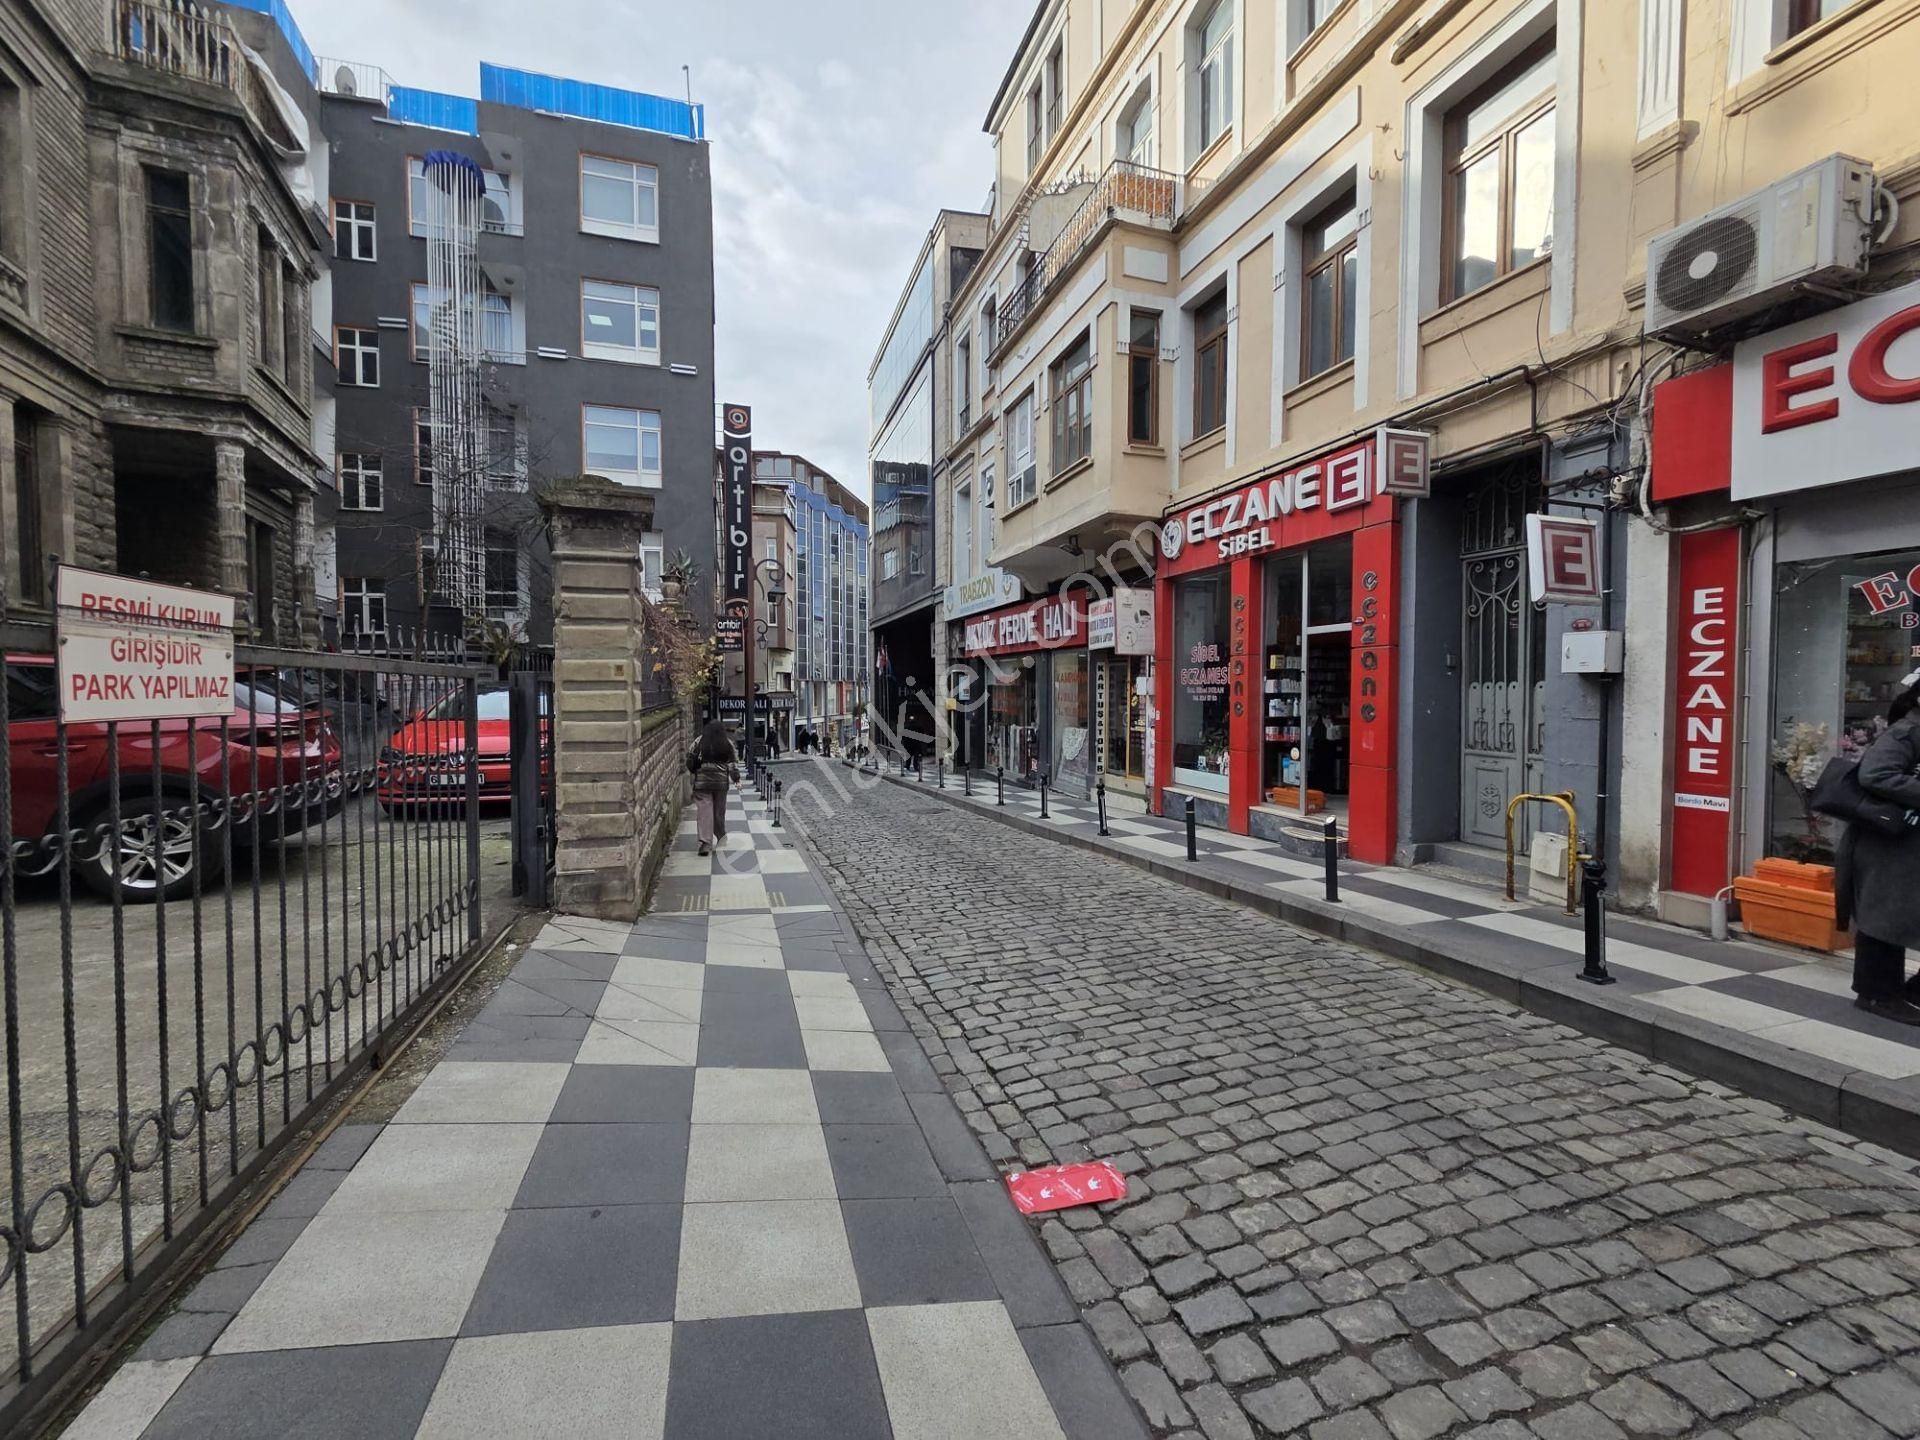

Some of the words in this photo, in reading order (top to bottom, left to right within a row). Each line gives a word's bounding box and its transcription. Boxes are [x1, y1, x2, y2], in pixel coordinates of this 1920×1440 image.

[1186, 464, 1322, 544] ECZANE
[1551, 534, 1588, 587] E
[960, 573, 995, 606] TRABZON
[81, 593, 152, 625] RESMİ
[158, 603, 221, 634] KURUM
[966, 615, 997, 651] AKYÜZ
[999, 610, 1037, 646] PERDE
[1043, 600, 1078, 640] HALI
[110, 631, 203, 670] GİRİŞİDİR
[1191, 641, 1220, 663] SİBEL
[1234, 595, 1246, 717] eczane
[1360, 570, 1378, 722] eczane
[72, 673, 135, 701] PARK
[138, 675, 229, 700] YAPILMAZ
[1686, 587, 1726, 775] ECZANE
[720, 699, 746, 709] DEKOR
[1703, 798, 1726, 808] Mavi
